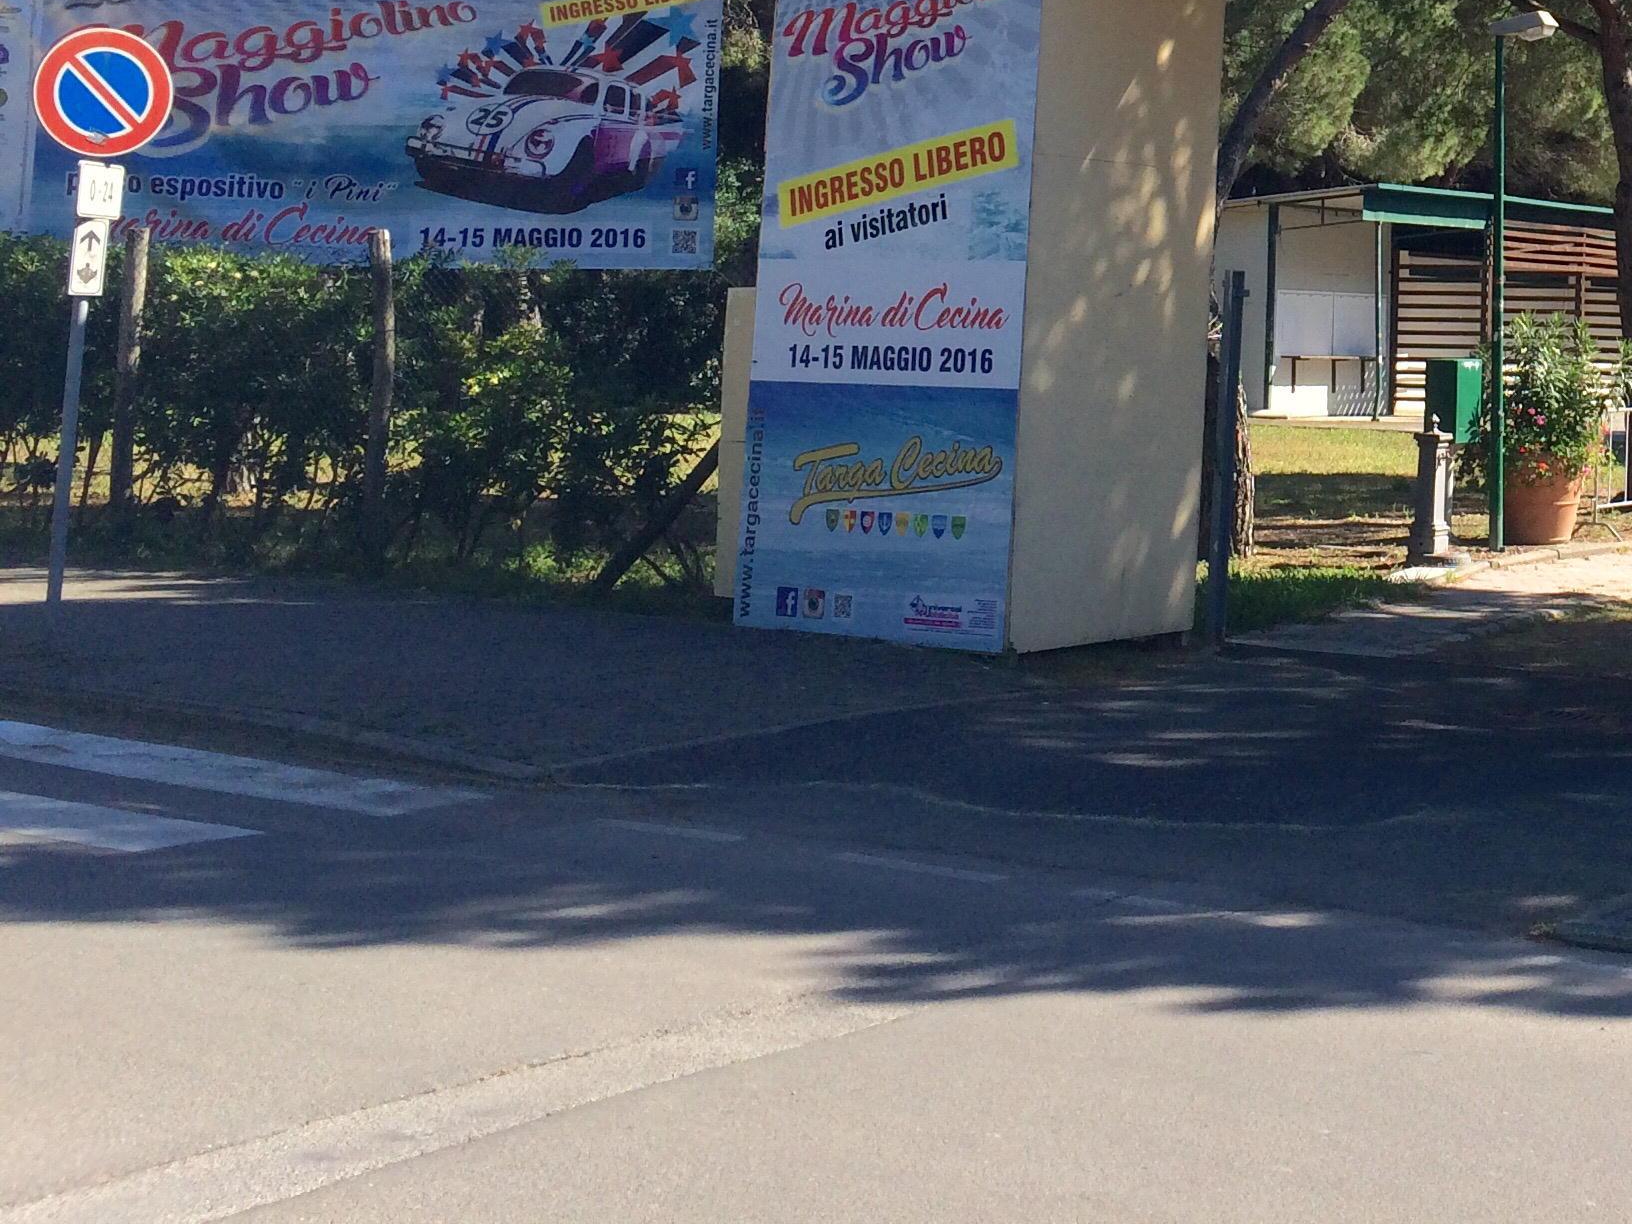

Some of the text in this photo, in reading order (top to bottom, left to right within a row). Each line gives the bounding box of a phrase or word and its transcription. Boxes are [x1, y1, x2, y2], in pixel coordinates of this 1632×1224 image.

[701, 18, 718, 151] www.targacecina.it
[823, 25, 973, 106] Show
[469, 107, 508, 127] 25
[150, 174, 284, 201] espositivo
[789, 131, 1006, 216] INGRESSO LIBERO
[221, 209, 264, 242] di
[420, 227, 647, 249] 14-15 MAGGIO 2016
[825, 193, 948, 250] ai visitatori
[779, 282, 1008, 337] Marina di Cecina
[788, 343, 994, 374] 14-15 MAGGIO 2016
[793, 436, 1003, 498] Targa Cecina
[740, 407, 765, 618] www.targacecina.it
